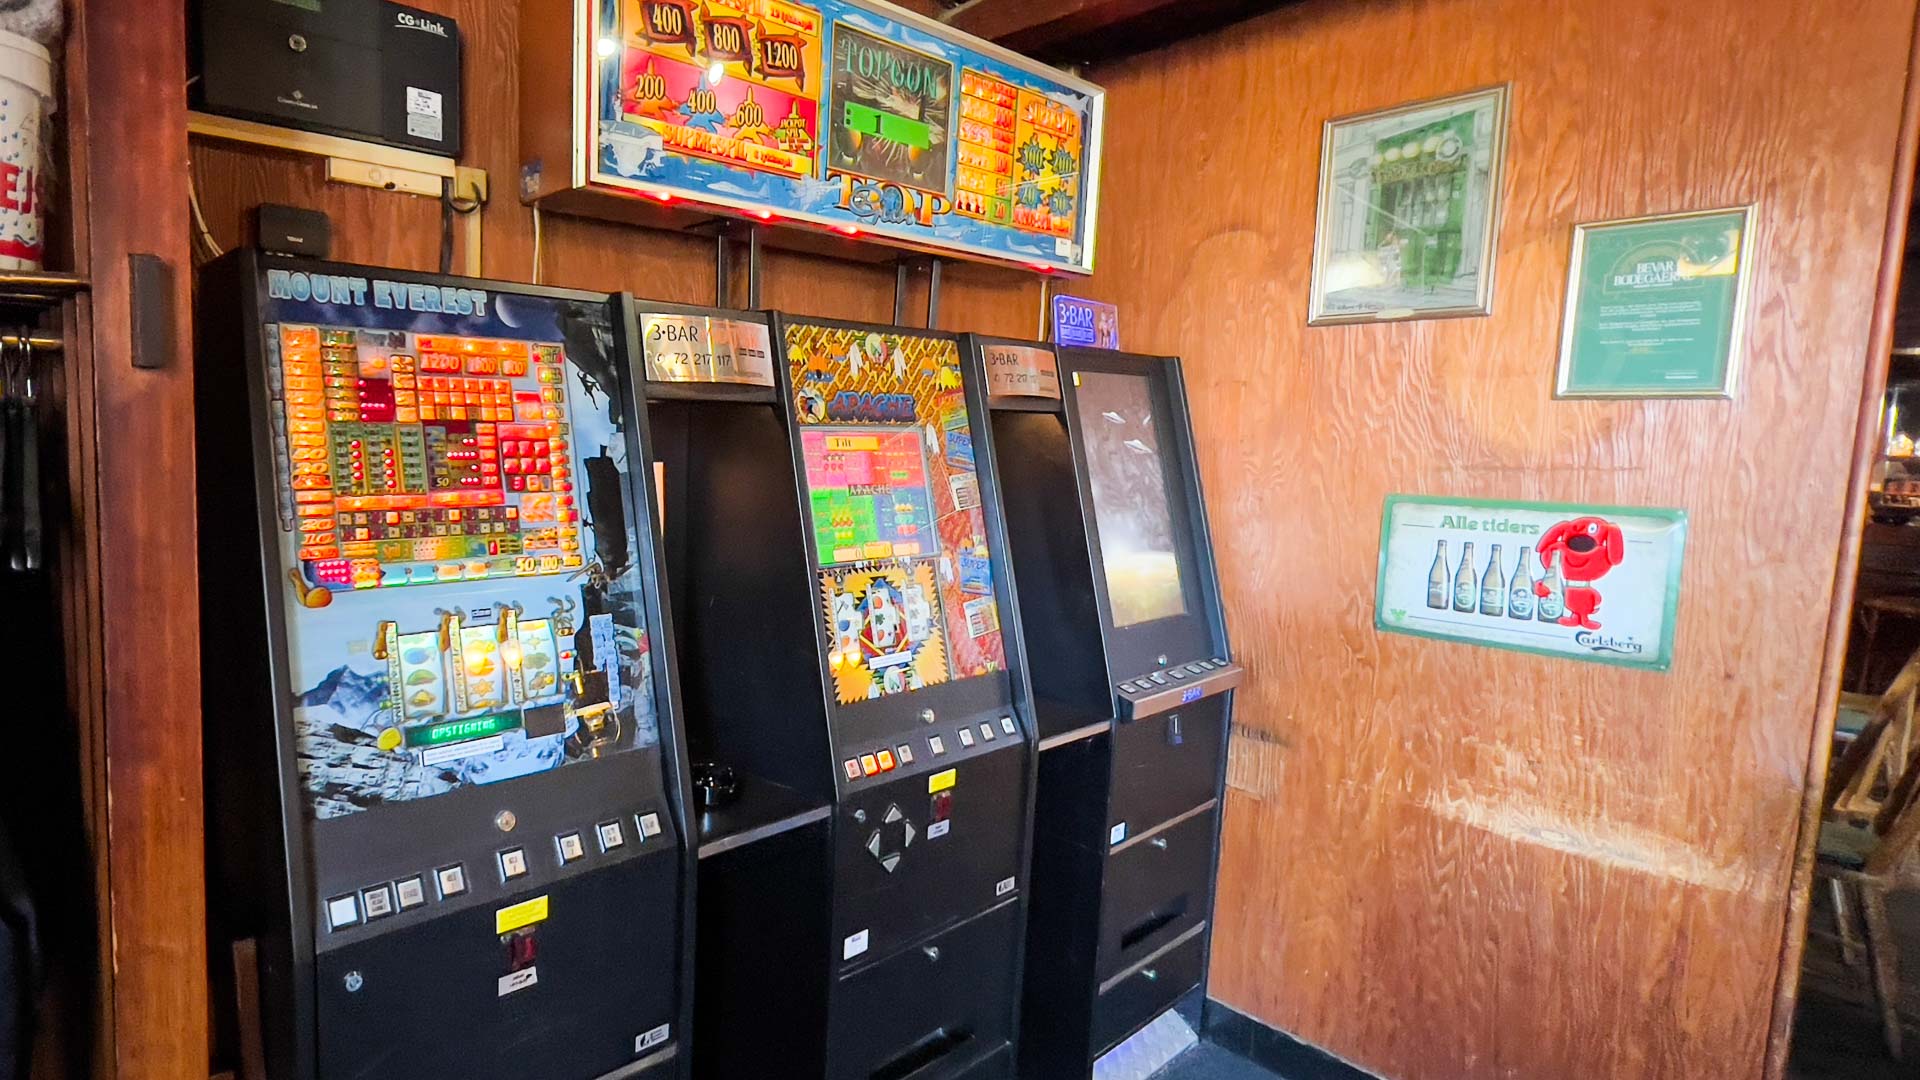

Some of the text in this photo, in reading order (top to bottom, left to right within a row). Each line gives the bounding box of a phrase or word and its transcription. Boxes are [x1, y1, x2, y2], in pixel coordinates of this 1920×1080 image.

[652, 3, 682, 36] 400
[713, 24, 740, 53] 800
[766, 40, 798, 70] 1200
[635, 73, 665, 100] 200
[687, 90, 716, 114] 400
[736, 106, 763, 127] 600
[1637, 260, 1676, 273] BEVAR
[268, 269, 488, 317] MOUNT EVEREST
[674, 352, 732, 367] 72 217 117
[828, 391, 915, 418] APACHE
[1440, 515, 1541, 535] Alle tiders
[515, 559, 535, 573] 50
[1575, 630, 1643, 654] Carlsberg
